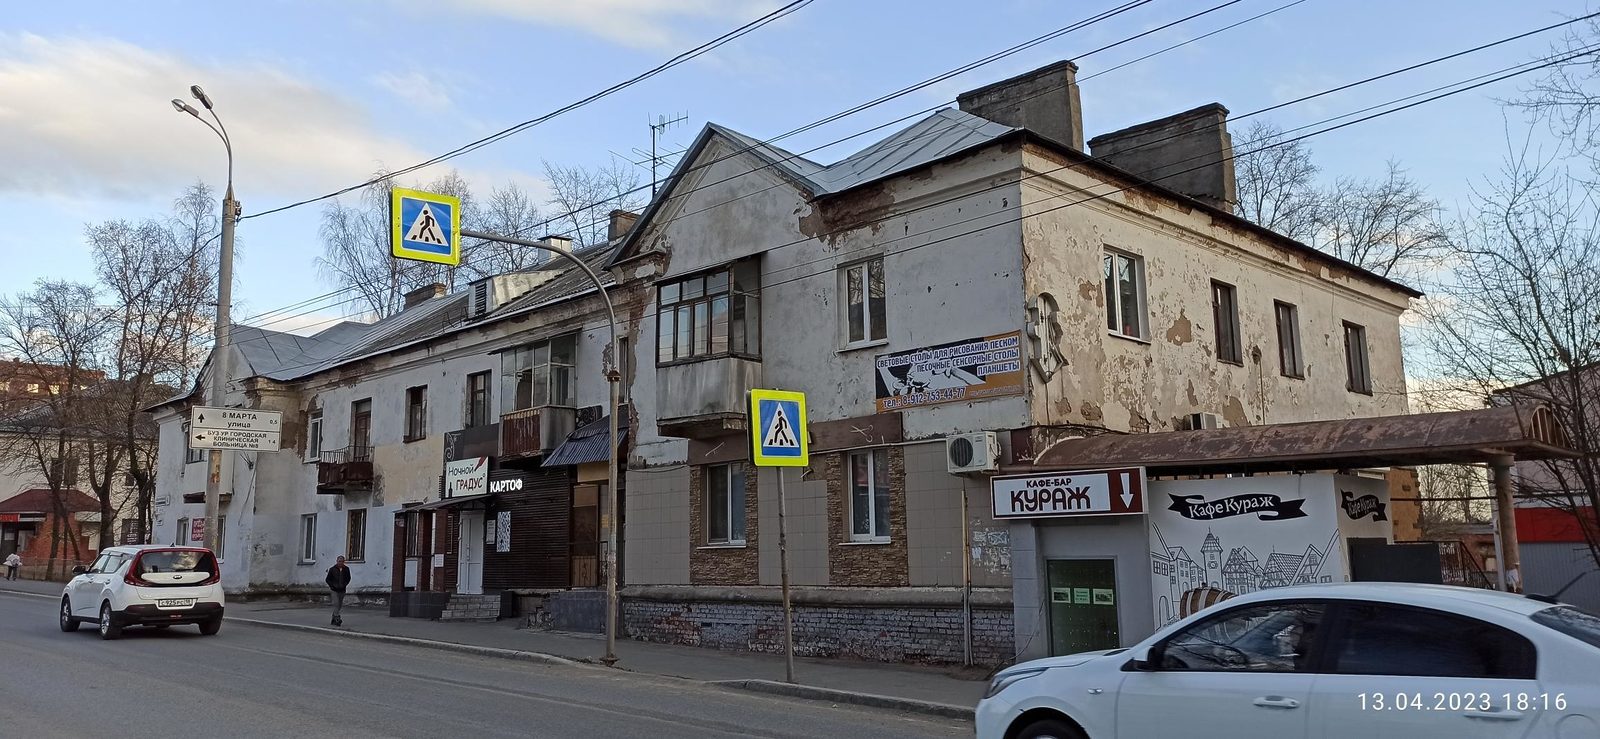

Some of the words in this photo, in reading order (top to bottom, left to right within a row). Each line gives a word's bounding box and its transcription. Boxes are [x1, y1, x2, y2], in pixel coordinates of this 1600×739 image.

[877, 355, 909, 369] СВЕТОВЫЕ
[910, 351, 933, 363] СТОЛЫ
[934, 348, 948, 360] ДЛЯ
[949, 342, 989, 357] РИСОВАНИЯ
[990, 336, 1018, 350] ПЕСКОМ
[916, 360, 951, 373] ПЕСОЧНЫЕ
[952, 353, 992, 367] СЕНСОРНЫЕ
[993, 349, 1019, 361] СТОЛЫ
[977, 361, 1020, 376] ПЛАНШЕТЫ
[902, 387, 966, 406] 8-912-753-44-77
[229, 412, 257, 420] МАРТА
[227, 421, 251, 429] улица
[448, 463, 474, 477] Ночной
[490, 479, 523, 493] КАРТОФ
[1026, 478, 1072, 488] КАФЕ-БАР
[1010, 486, 1091, 513] КУРАЖ
[1188, 502, 1224, 519] Кафе
[1225, 496, 1274, 513] Кураж
